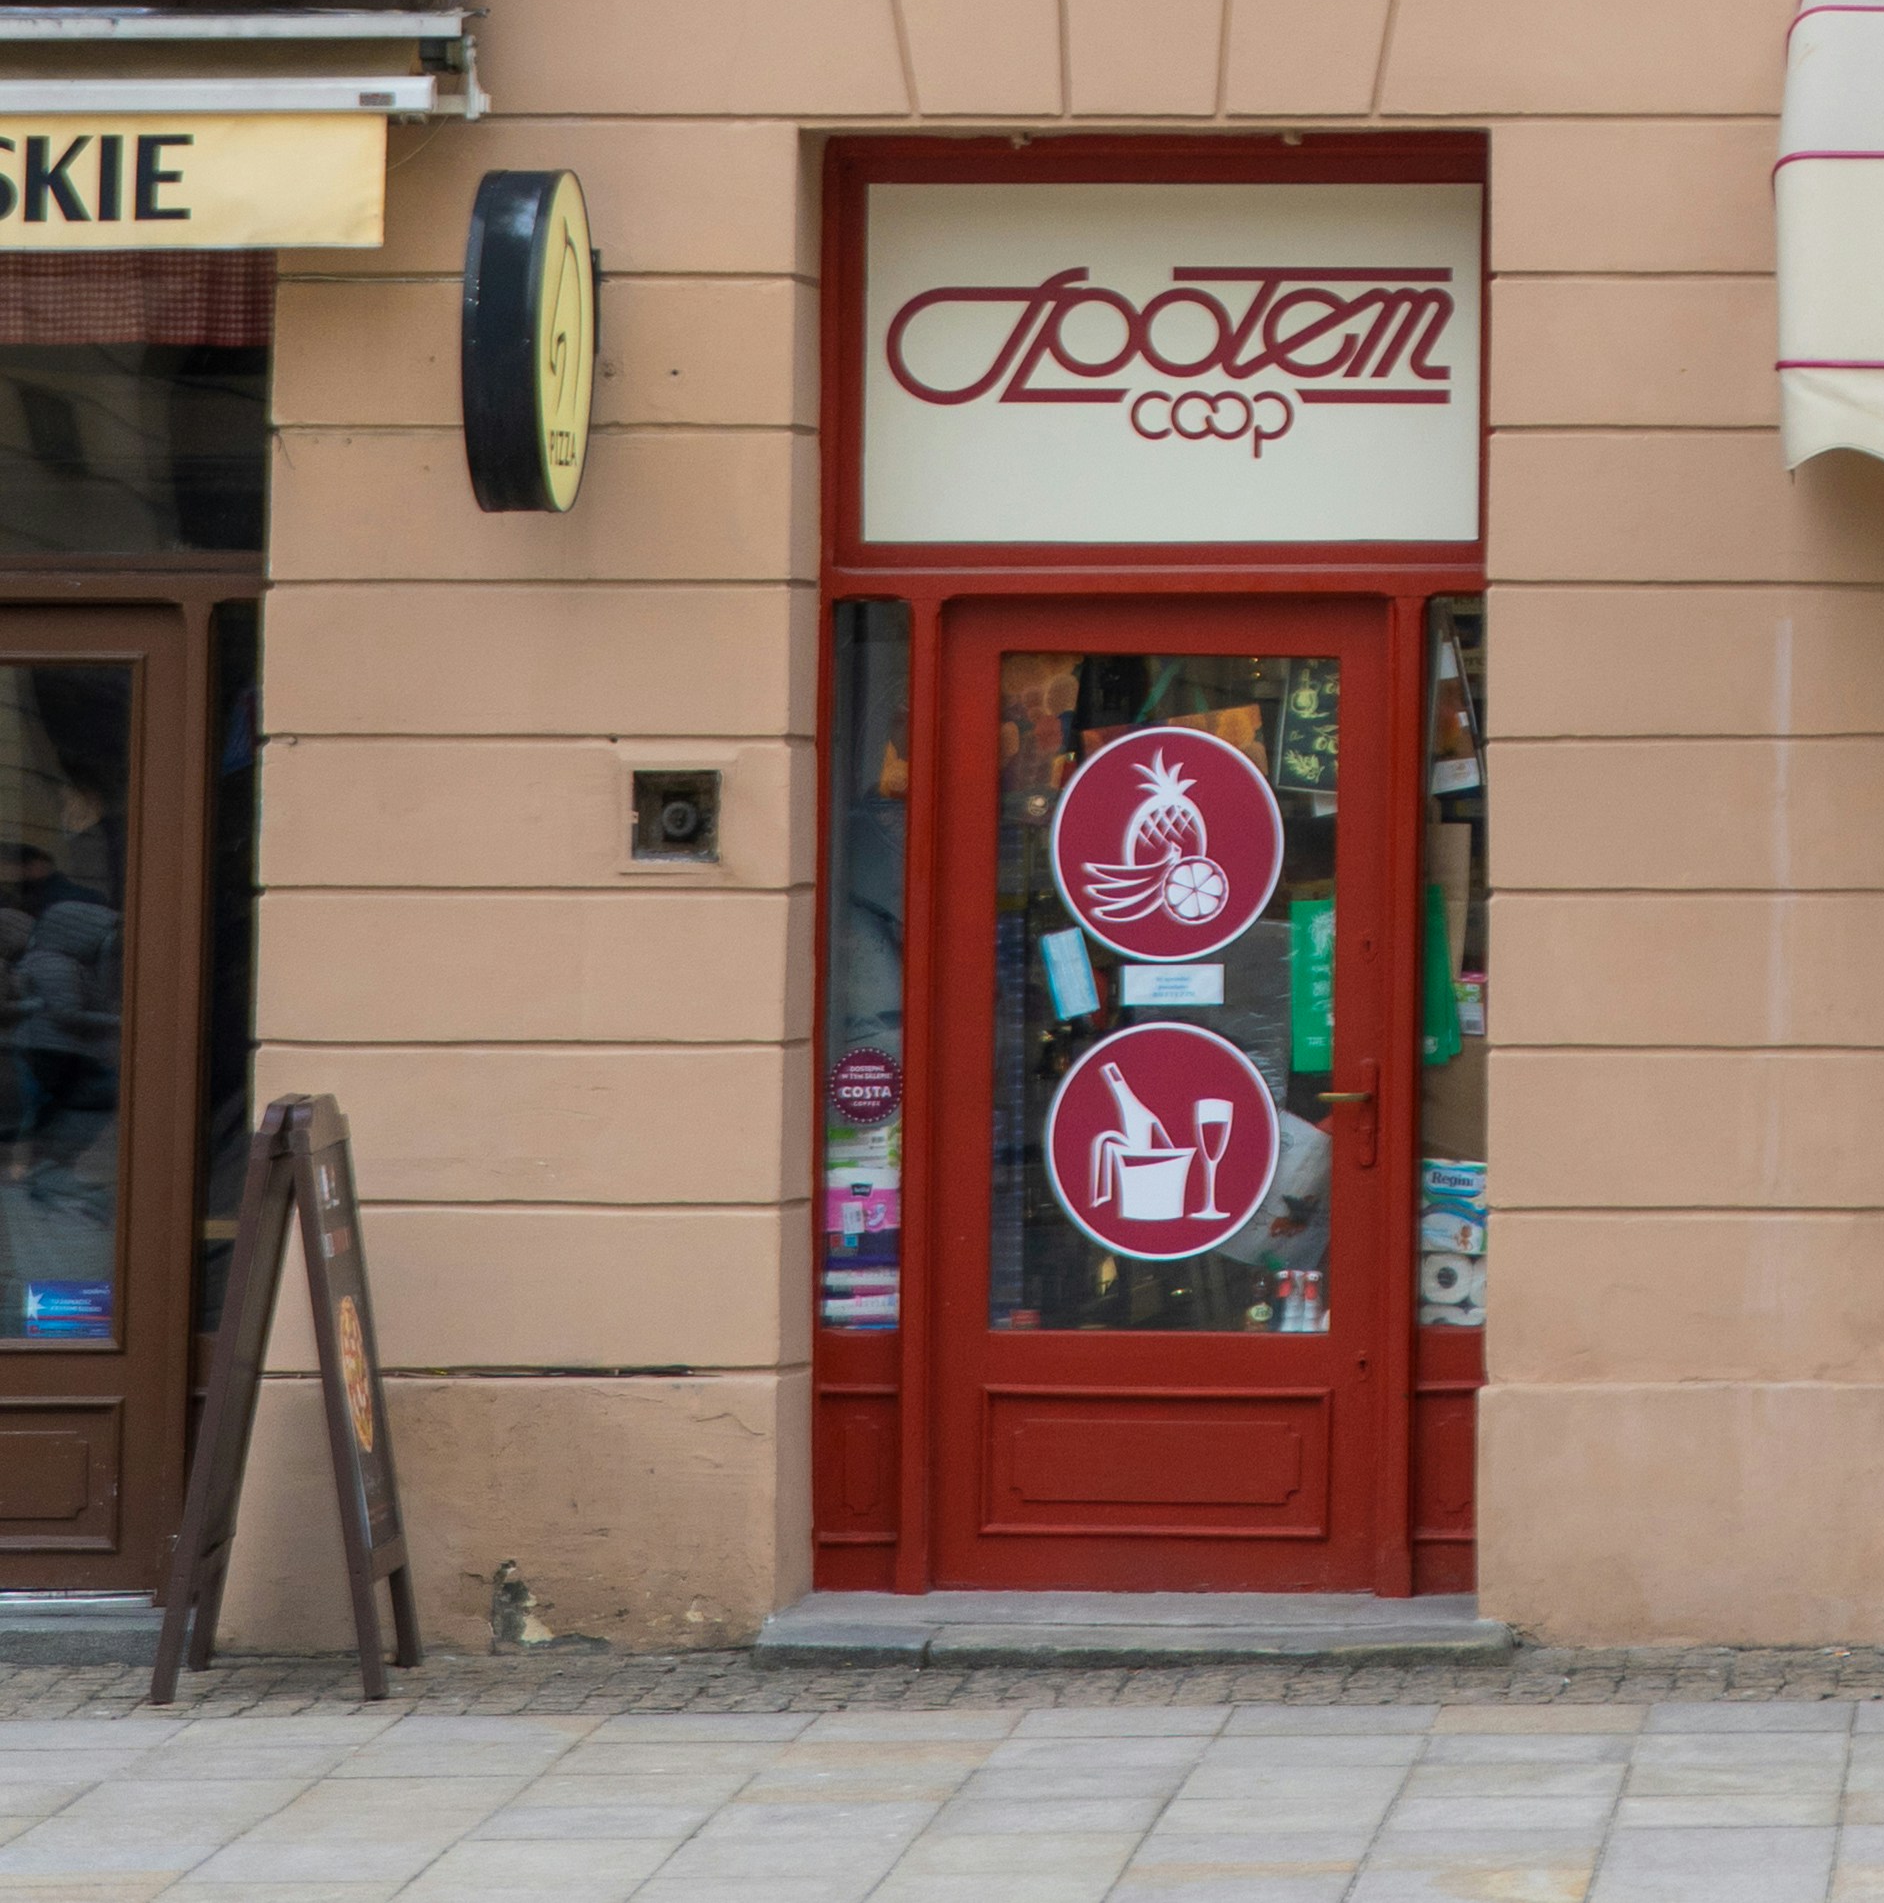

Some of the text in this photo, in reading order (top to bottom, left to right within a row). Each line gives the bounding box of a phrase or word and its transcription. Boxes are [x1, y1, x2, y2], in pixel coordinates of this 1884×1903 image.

[1131, 389, 1293, 459] coop
[550, 429, 577, 467] PIZZA
[842, 1086, 892, 1099] COSTA
